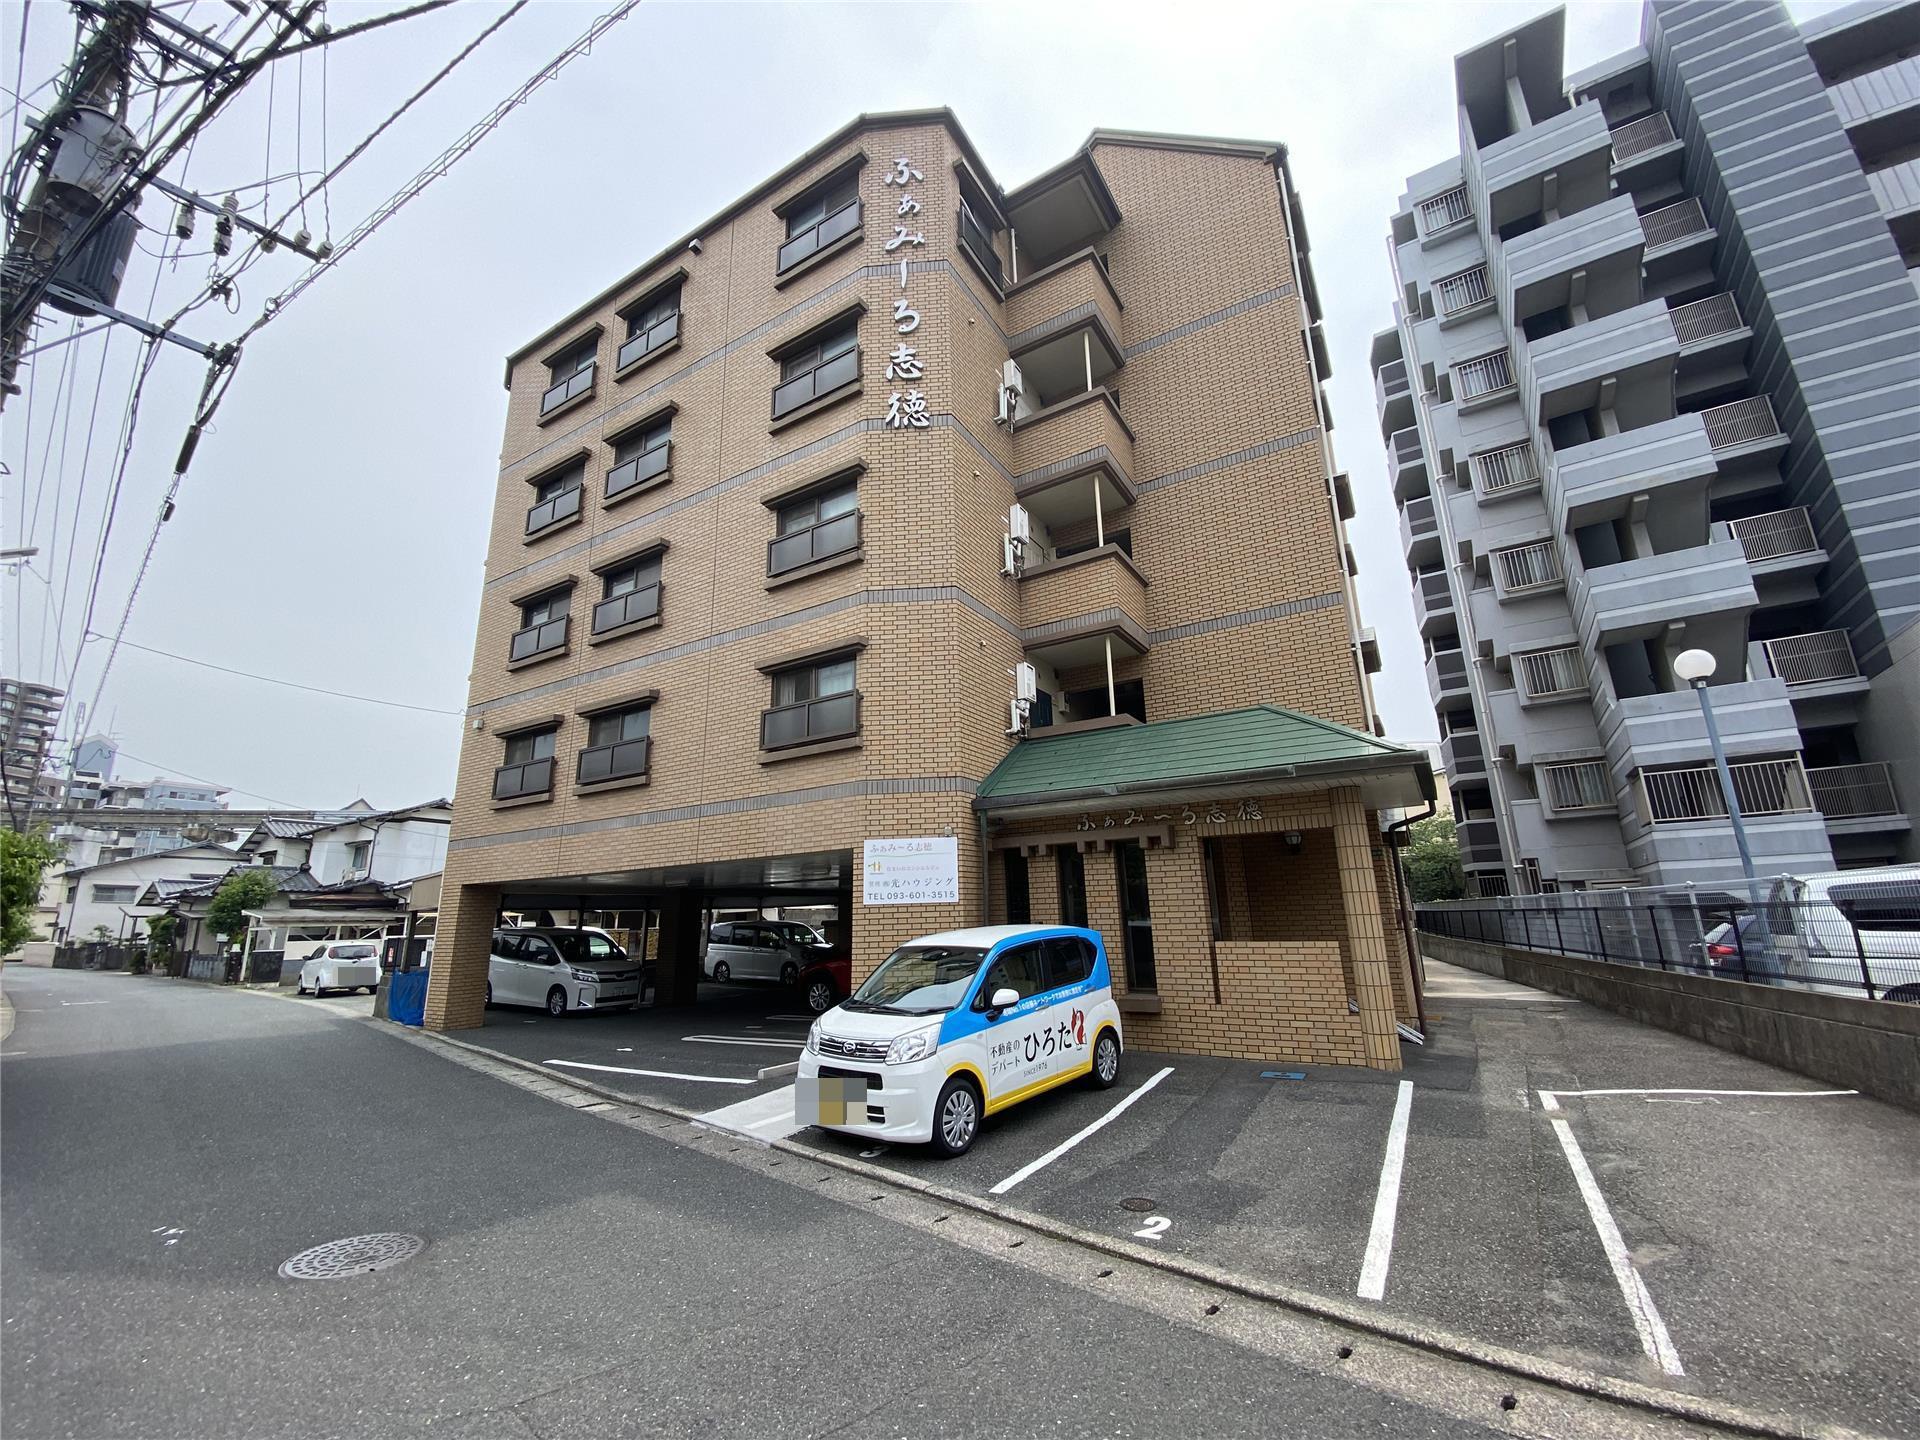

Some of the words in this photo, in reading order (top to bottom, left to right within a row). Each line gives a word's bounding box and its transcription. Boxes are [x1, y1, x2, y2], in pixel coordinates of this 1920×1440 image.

[868, 893, 885, 901] TEL
[887, 890, 955, 900] 093-601-3515
[990, 1039, 1020, 1059] 不動産の
[1024, 1021, 1072, 1062] ひろた
[991, 1056, 1021, 1076] デパート
[1133, 1216, 1172, 1240] 2
